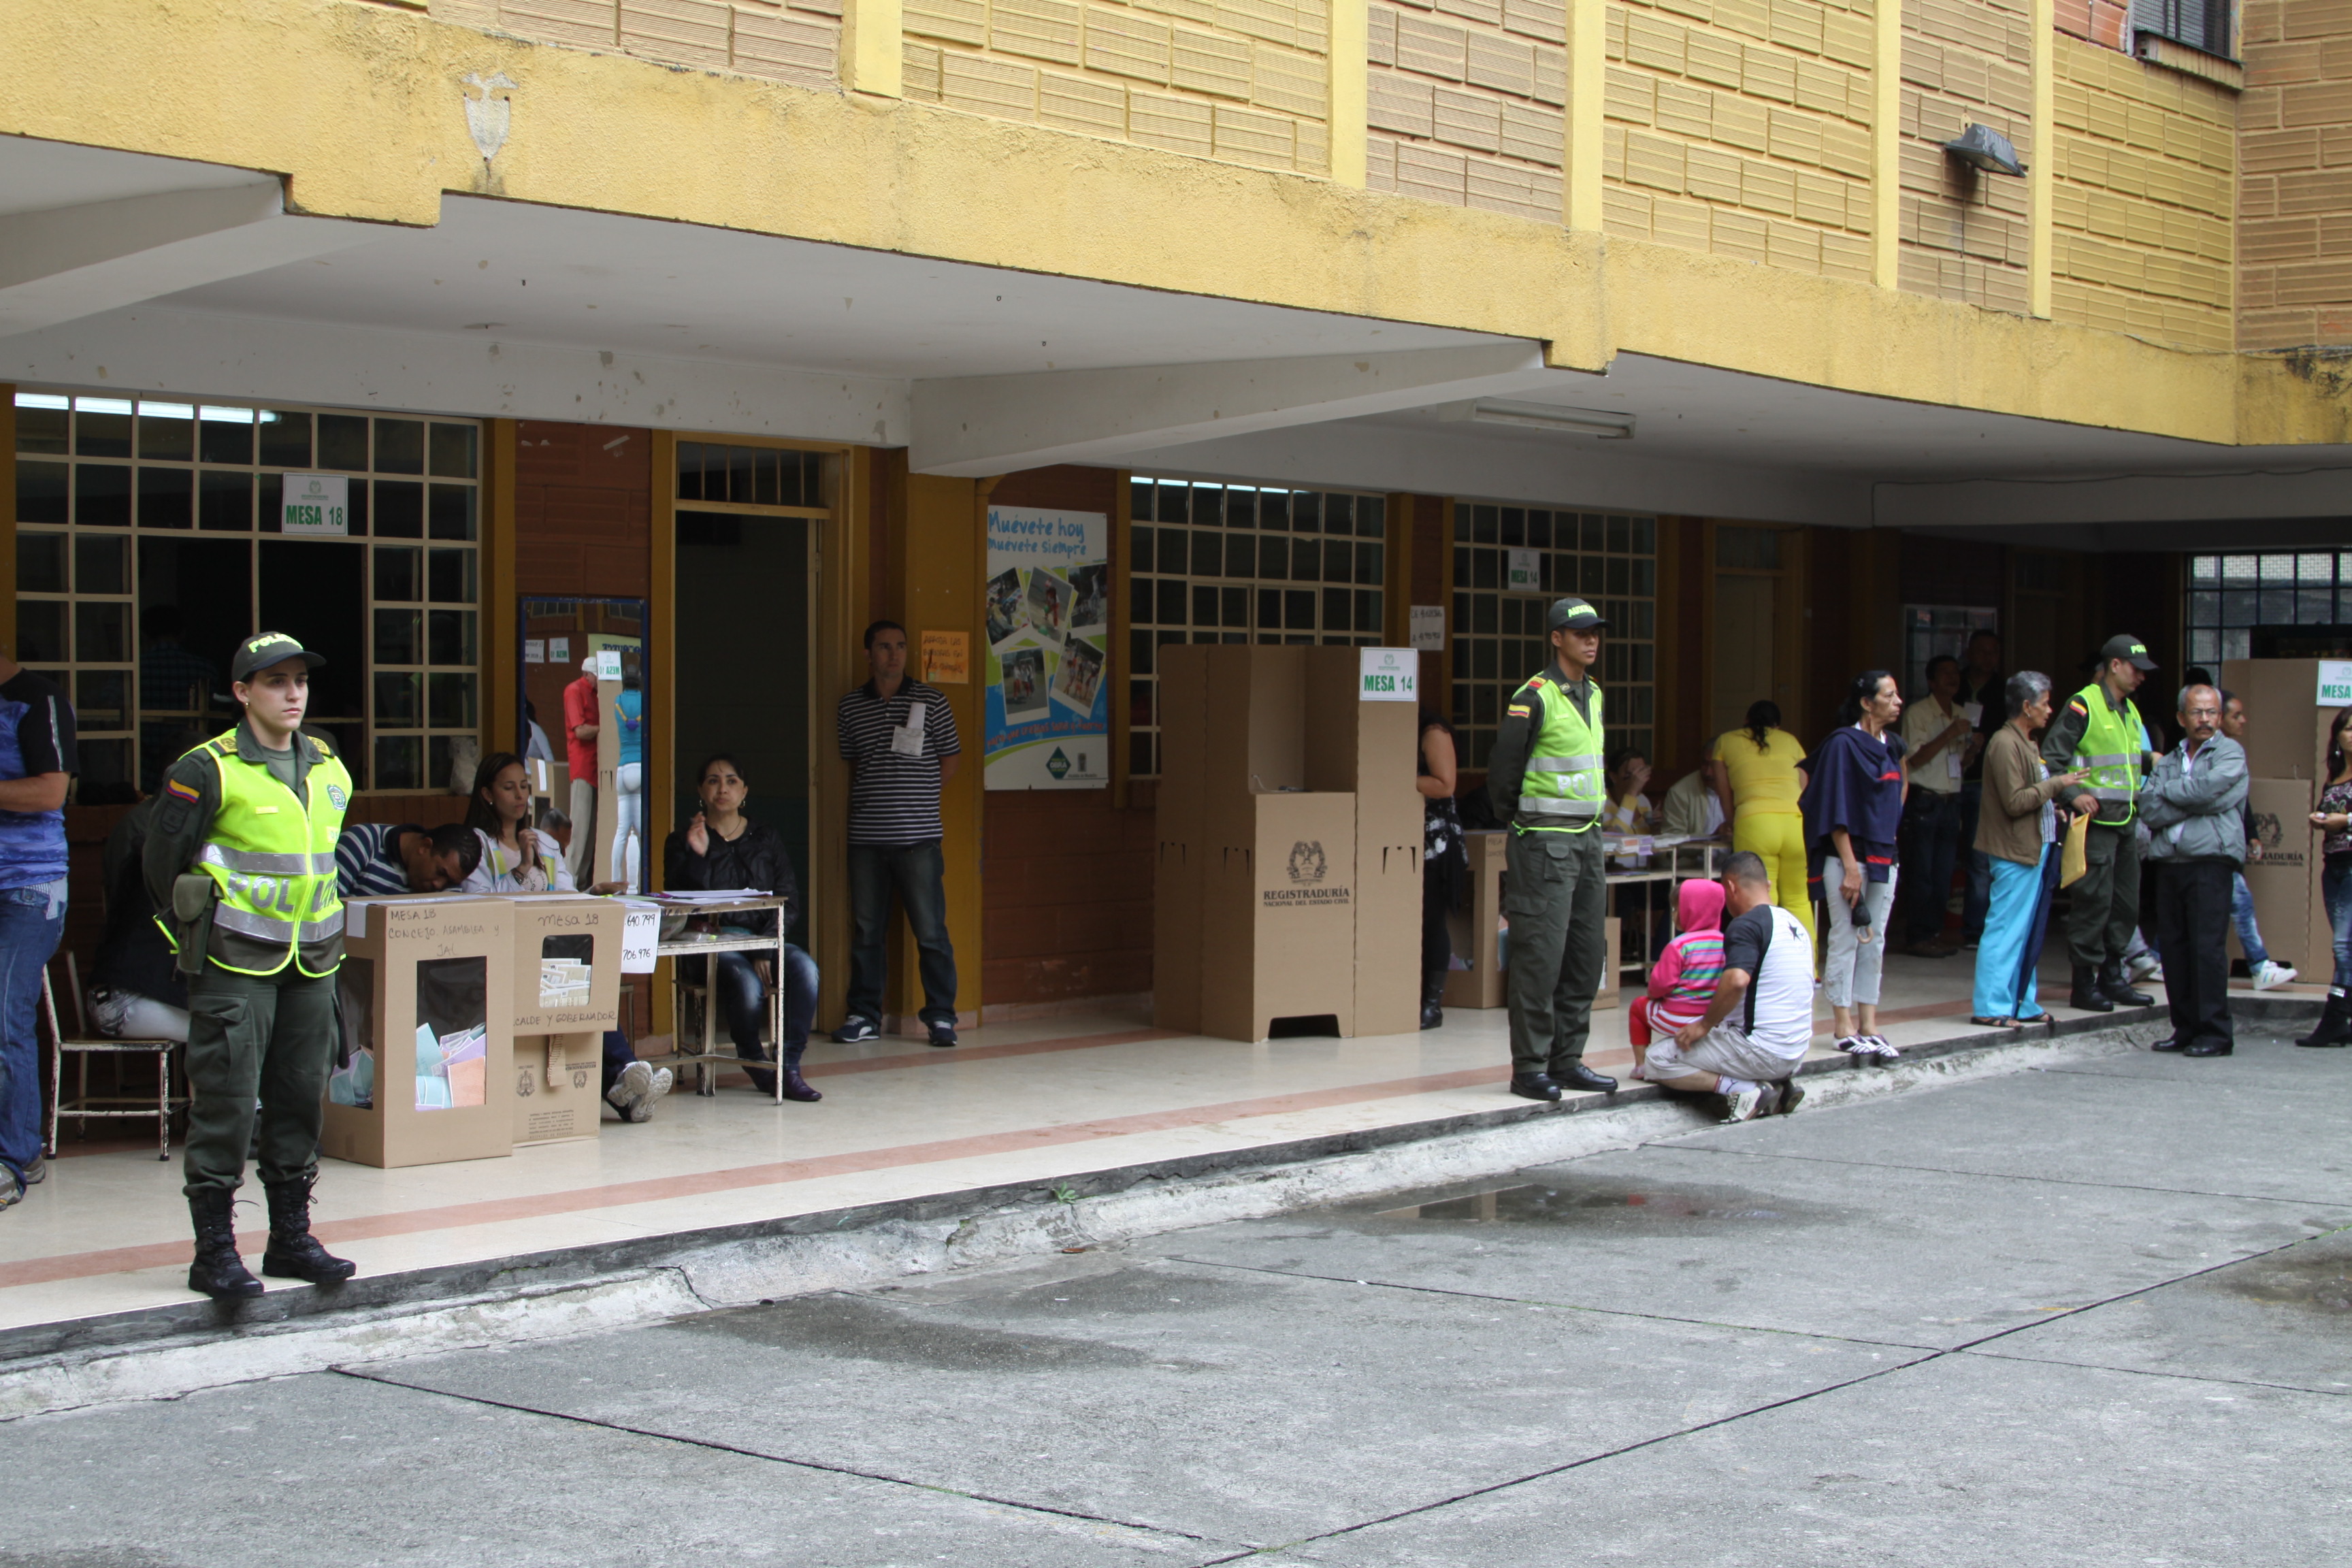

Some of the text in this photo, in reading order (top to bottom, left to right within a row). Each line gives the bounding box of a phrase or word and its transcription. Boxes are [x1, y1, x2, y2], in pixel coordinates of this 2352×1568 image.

[286, 504, 343, 525] MESA 18
[988, 510, 1084, 544] Muévete hoy
[1041, 539, 1087, 559] siempre
[1511, 569, 1528, 584] MESA
[1364, 674, 1413, 692] MESA 14
[2321, 684, 2351, 699] MESA
[1264, 885, 1350, 900] REGISTRADURÍA
[391, 909, 437, 921] MESA 18
[585, 913, 599, 926] 18
[513, 1015, 541, 1026] CALDE
[555, 1011, 617, 1023] GOBERNADOR
